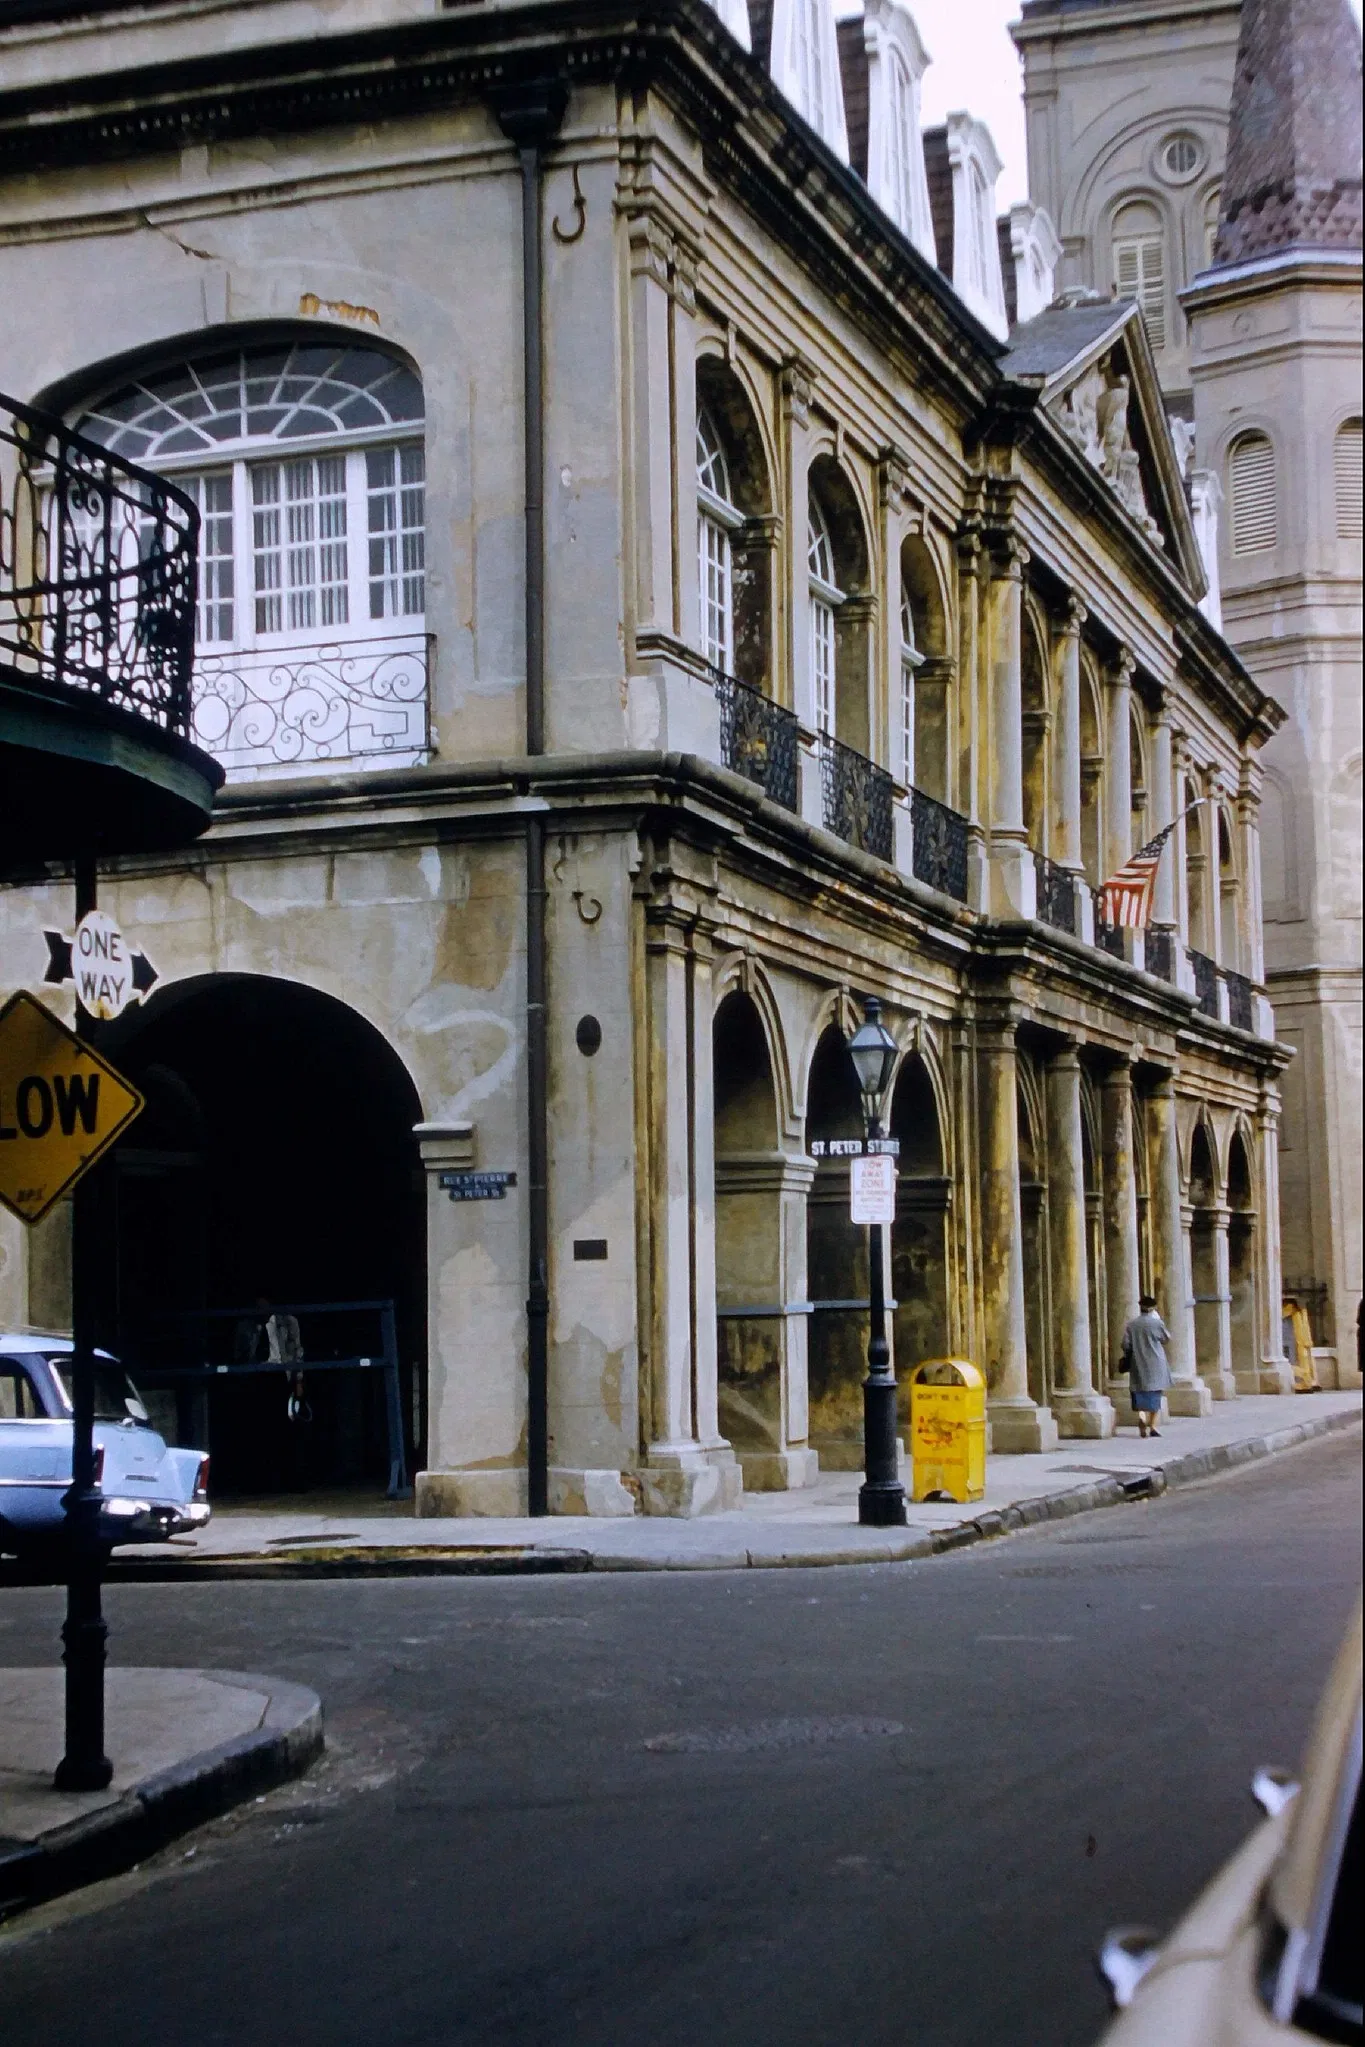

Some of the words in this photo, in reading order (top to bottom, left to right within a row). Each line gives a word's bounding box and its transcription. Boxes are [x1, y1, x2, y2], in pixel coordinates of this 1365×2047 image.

[79, 927, 122, 962] ONE
[80, 970, 125, 1004] WAY
[829, 1140, 862, 1155] PETER
